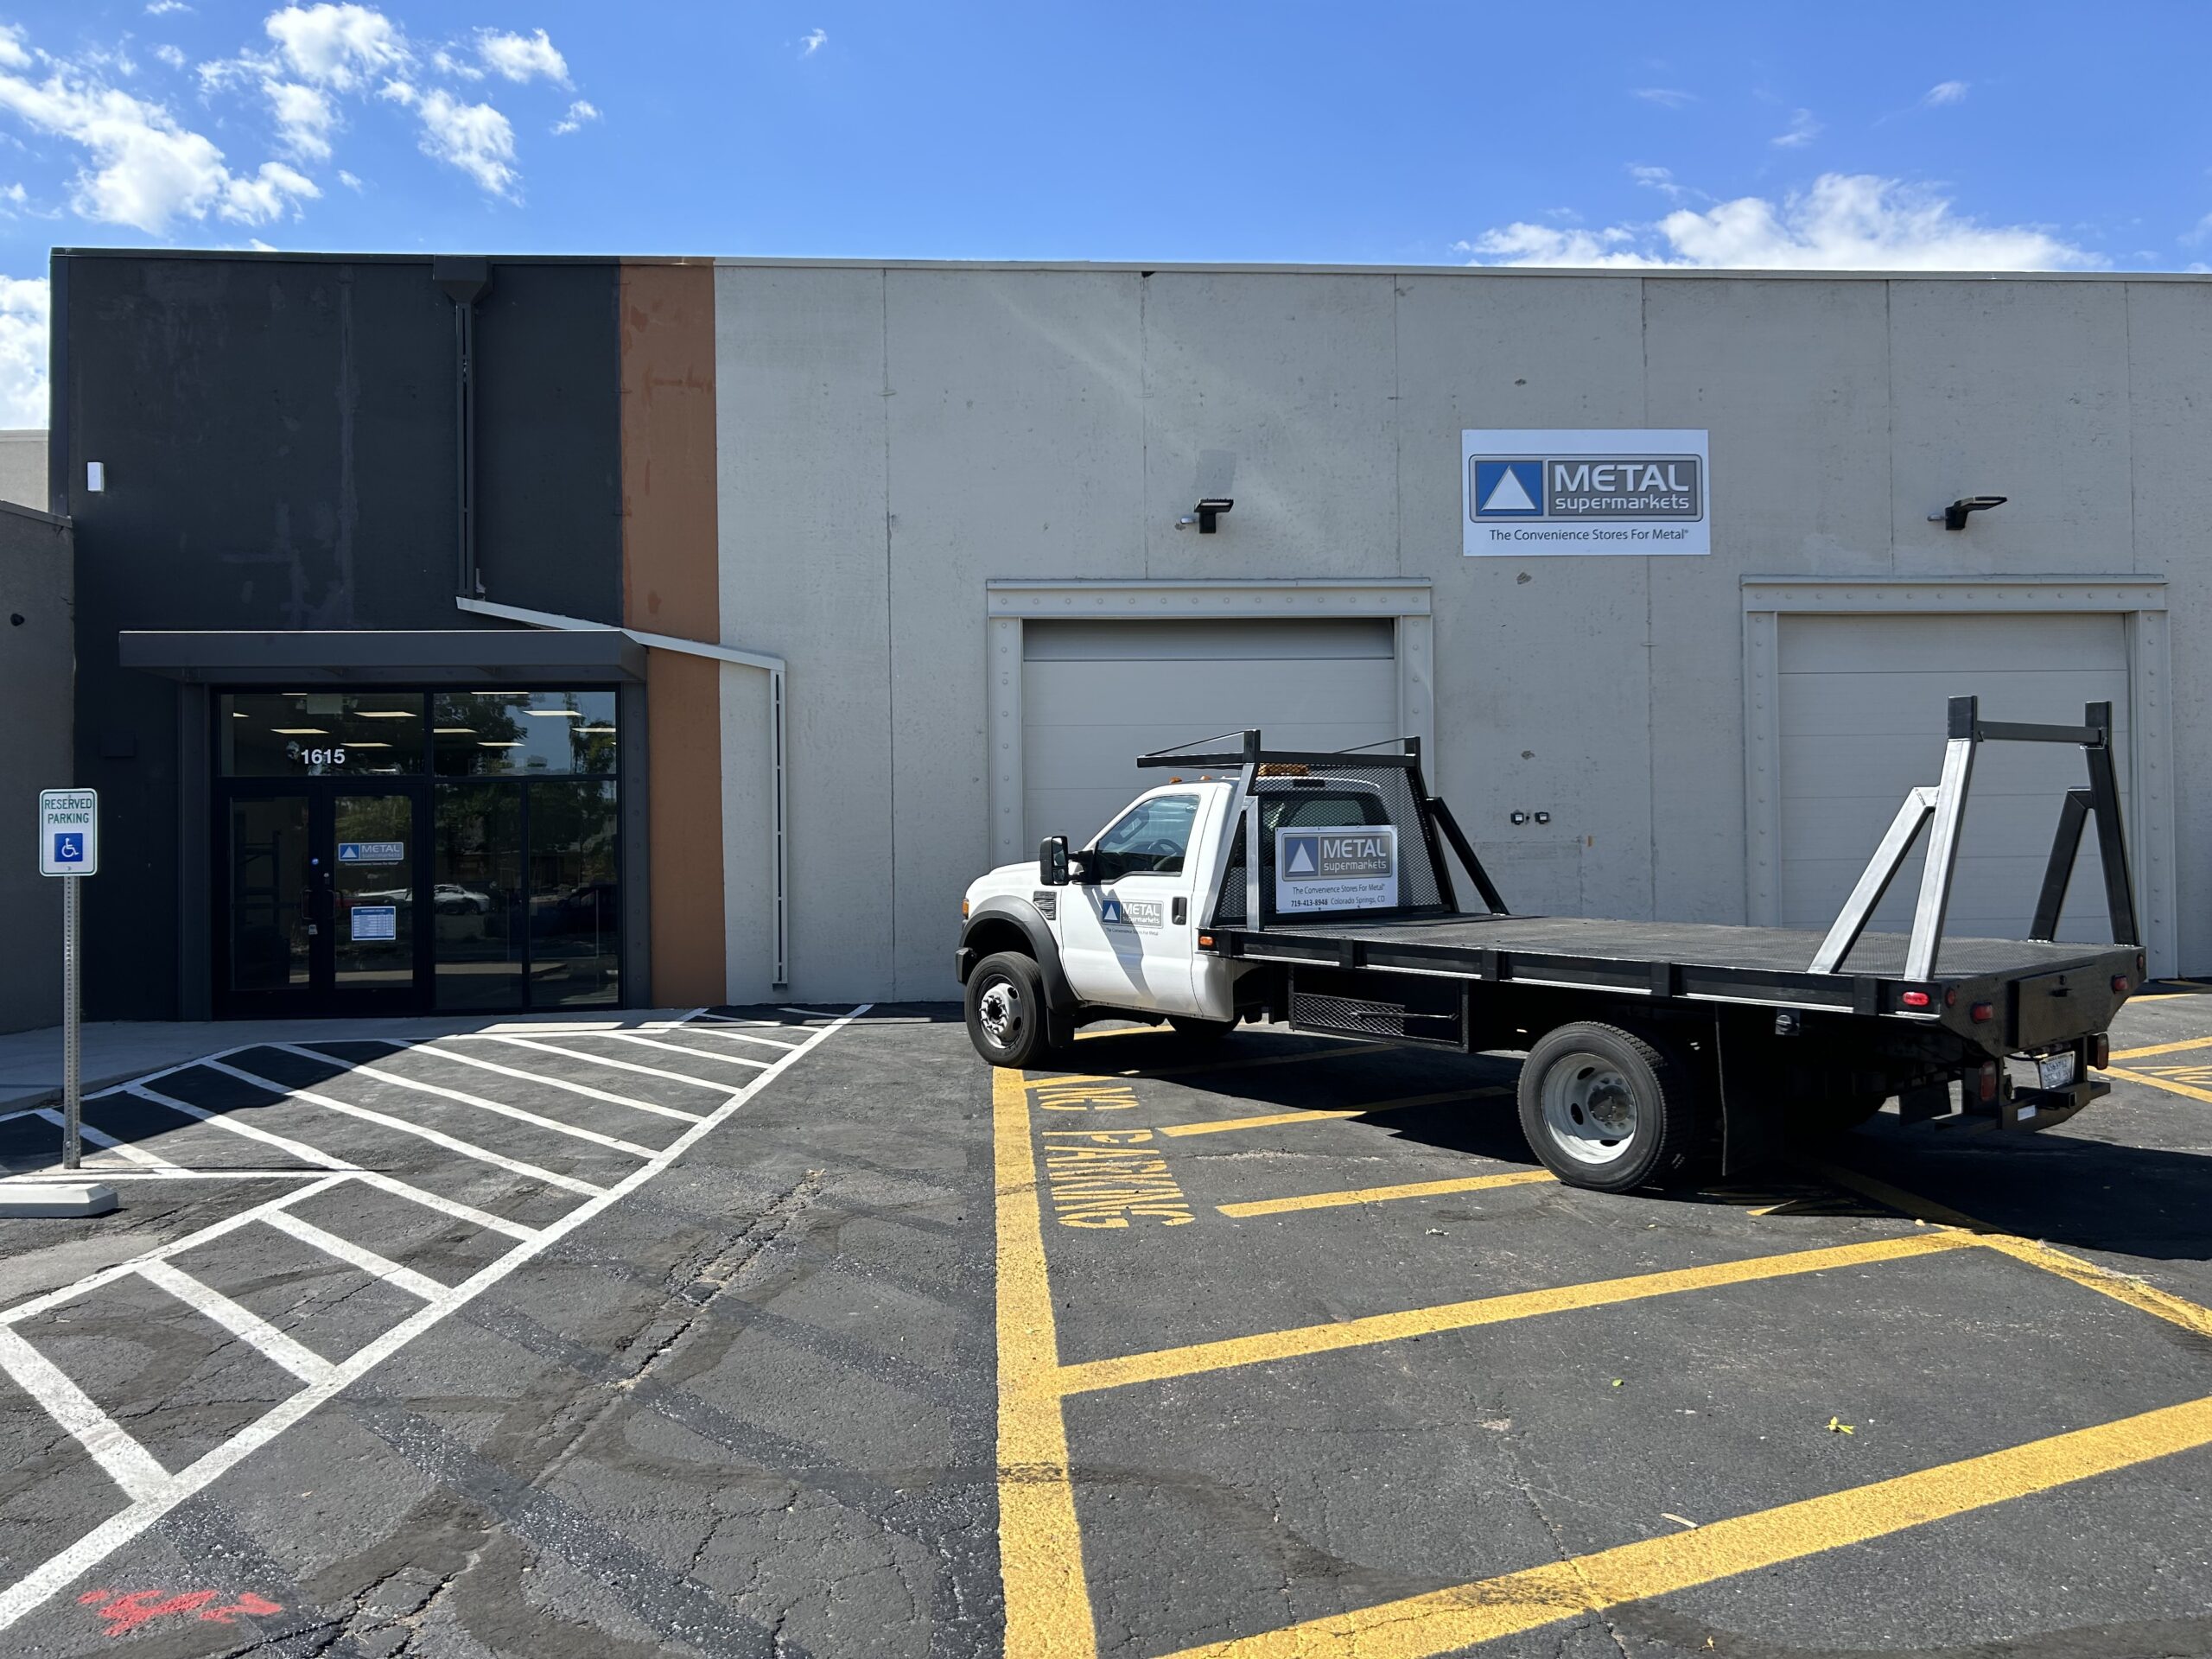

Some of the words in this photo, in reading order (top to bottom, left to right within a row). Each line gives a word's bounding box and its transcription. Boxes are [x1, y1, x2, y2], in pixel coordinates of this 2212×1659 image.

[1555, 464, 1689, 493] METAL
[1555, 494, 1689, 513] supermarkets
[1490, 530, 1511, 541] The
[1514, 529, 1589, 541] Convenience
[1592, 529, 1628, 540] Stores
[1631, 529, 1650, 540] For
[301, 748, 346, 765] 1615
[44, 798, 92, 810] RESERVED
[48, 812, 90, 824] PARKING
[361, 844, 400, 853] METAL
[1323, 838, 1387, 859] METAL
[1324, 860, 1387, 873] supermarkets
[1304, 886, 1340, 894] Convenience
[1122, 902, 1160, 917] METAL
[1291, 899, 1328, 907] 719-413-8948
[1037, 1086, 1140, 1111] NO
[1042, 1128, 1196, 1229] PARKING
